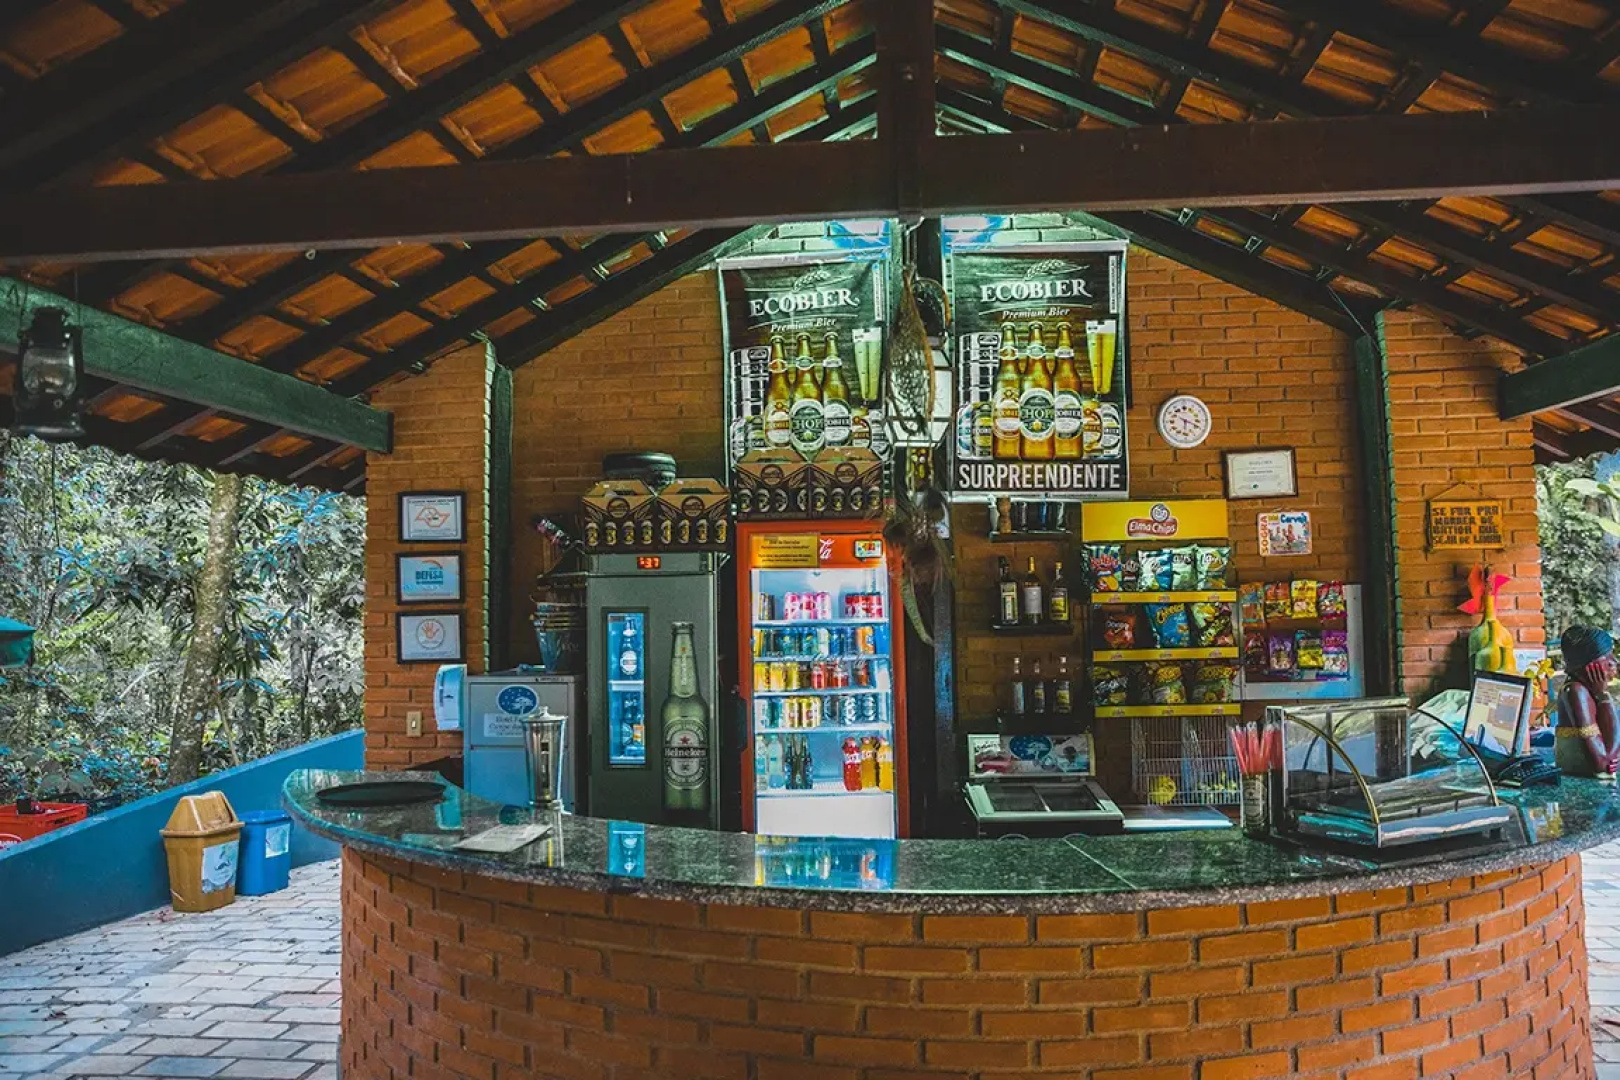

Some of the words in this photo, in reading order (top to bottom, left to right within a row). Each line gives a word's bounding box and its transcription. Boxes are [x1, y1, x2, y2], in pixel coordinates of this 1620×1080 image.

[980, 279, 1092, 302] ECOBIER
[749, 288, 860, 317] ECOBIER
[1002, 308, 1046, 320] Premium
[1048, 306, 1070, 317] Bier
[771, 321, 814, 333] Premium
[815, 317, 836, 327] Bier
[959, 463, 1121, 489] SURPREENDENTE
[1433, 508, 1446, 516] SE
[1451, 507, 1471, 516] FOR
[1477, 505, 1499, 515] PRA
[1129, 521, 1151, 531] Elma
[1152, 521, 1176, 534] Chips
[1260, 516, 1268, 554] SOGRA
[664, 747, 706, 757] Heineken
